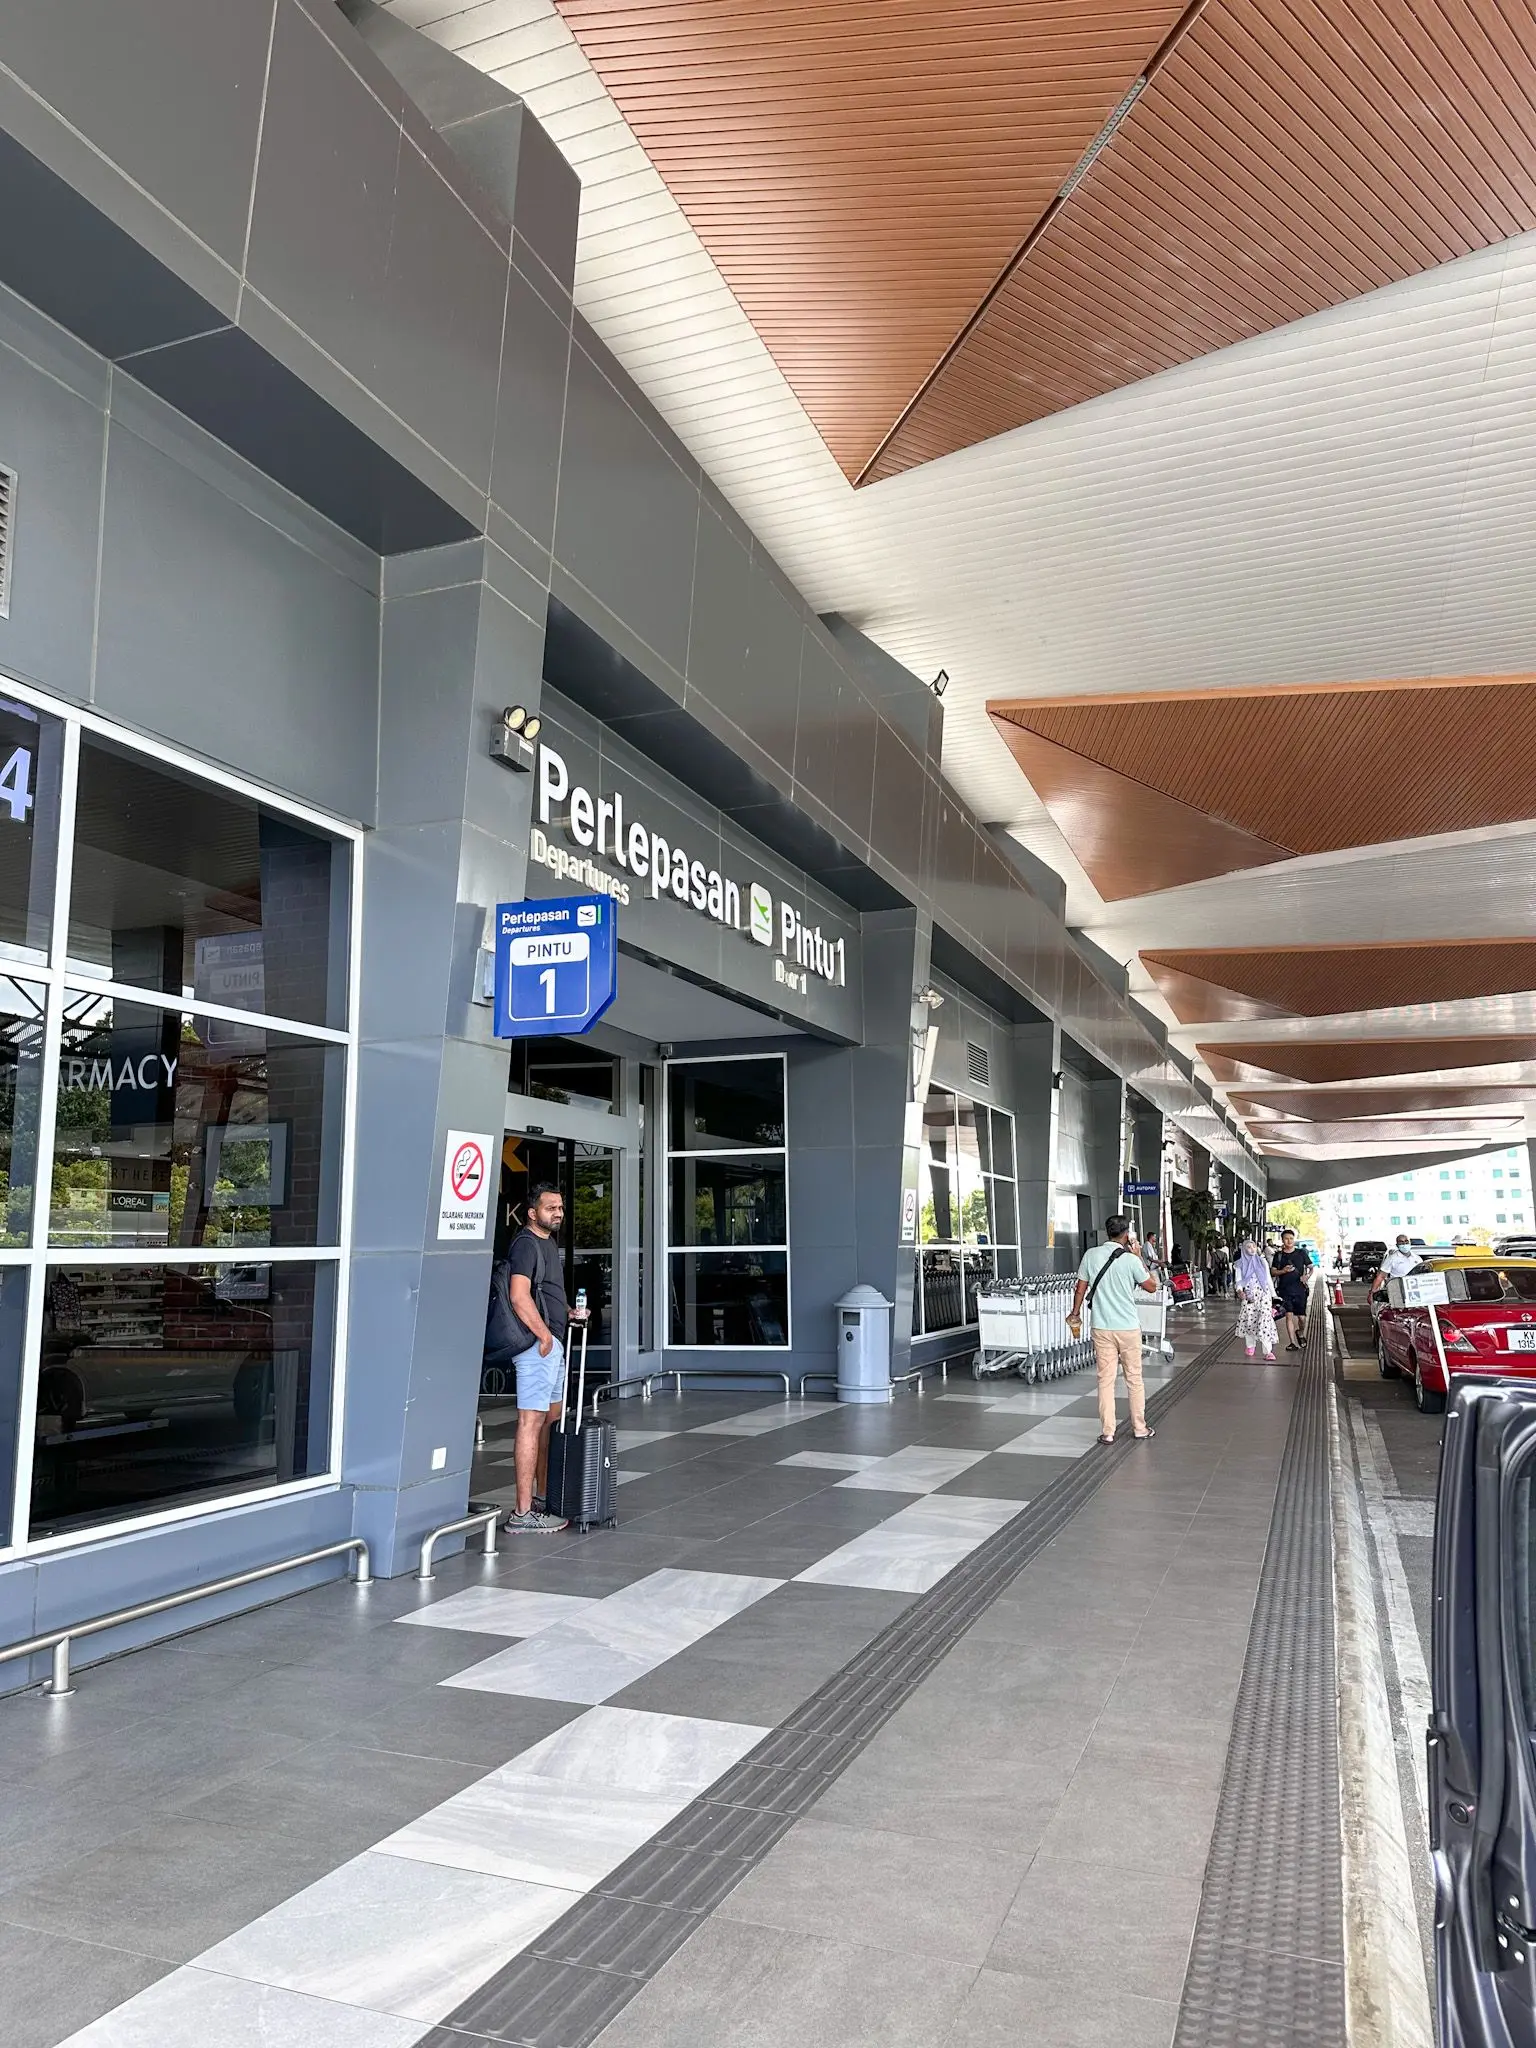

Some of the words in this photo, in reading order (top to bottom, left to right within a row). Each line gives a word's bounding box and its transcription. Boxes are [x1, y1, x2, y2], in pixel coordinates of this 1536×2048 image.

[532, 828, 630, 906] Departures
[539, 743, 741, 930] Perlepasan
[781, 901, 834, 980] Pintu
[838, 937, 846, 987] 1
[502, 909, 570, 926] Perlepasan
[502, 925, 541, 935] Departures
[527, 941, 572, 958] PINTU
[539, 968, 556, 1014] 1
[800, 973, 807, 995] 1
[441, 1211, 464, 1219] DILARANG
[464, 1211, 485, 1219] MEROKOK
[449, 1222, 456, 1230] NO
[456, 1222, 476, 1230] SMOKING
[1523, 1331, 1535, 1340] KV
[1518, 1340, 1536, 1349] 1315
